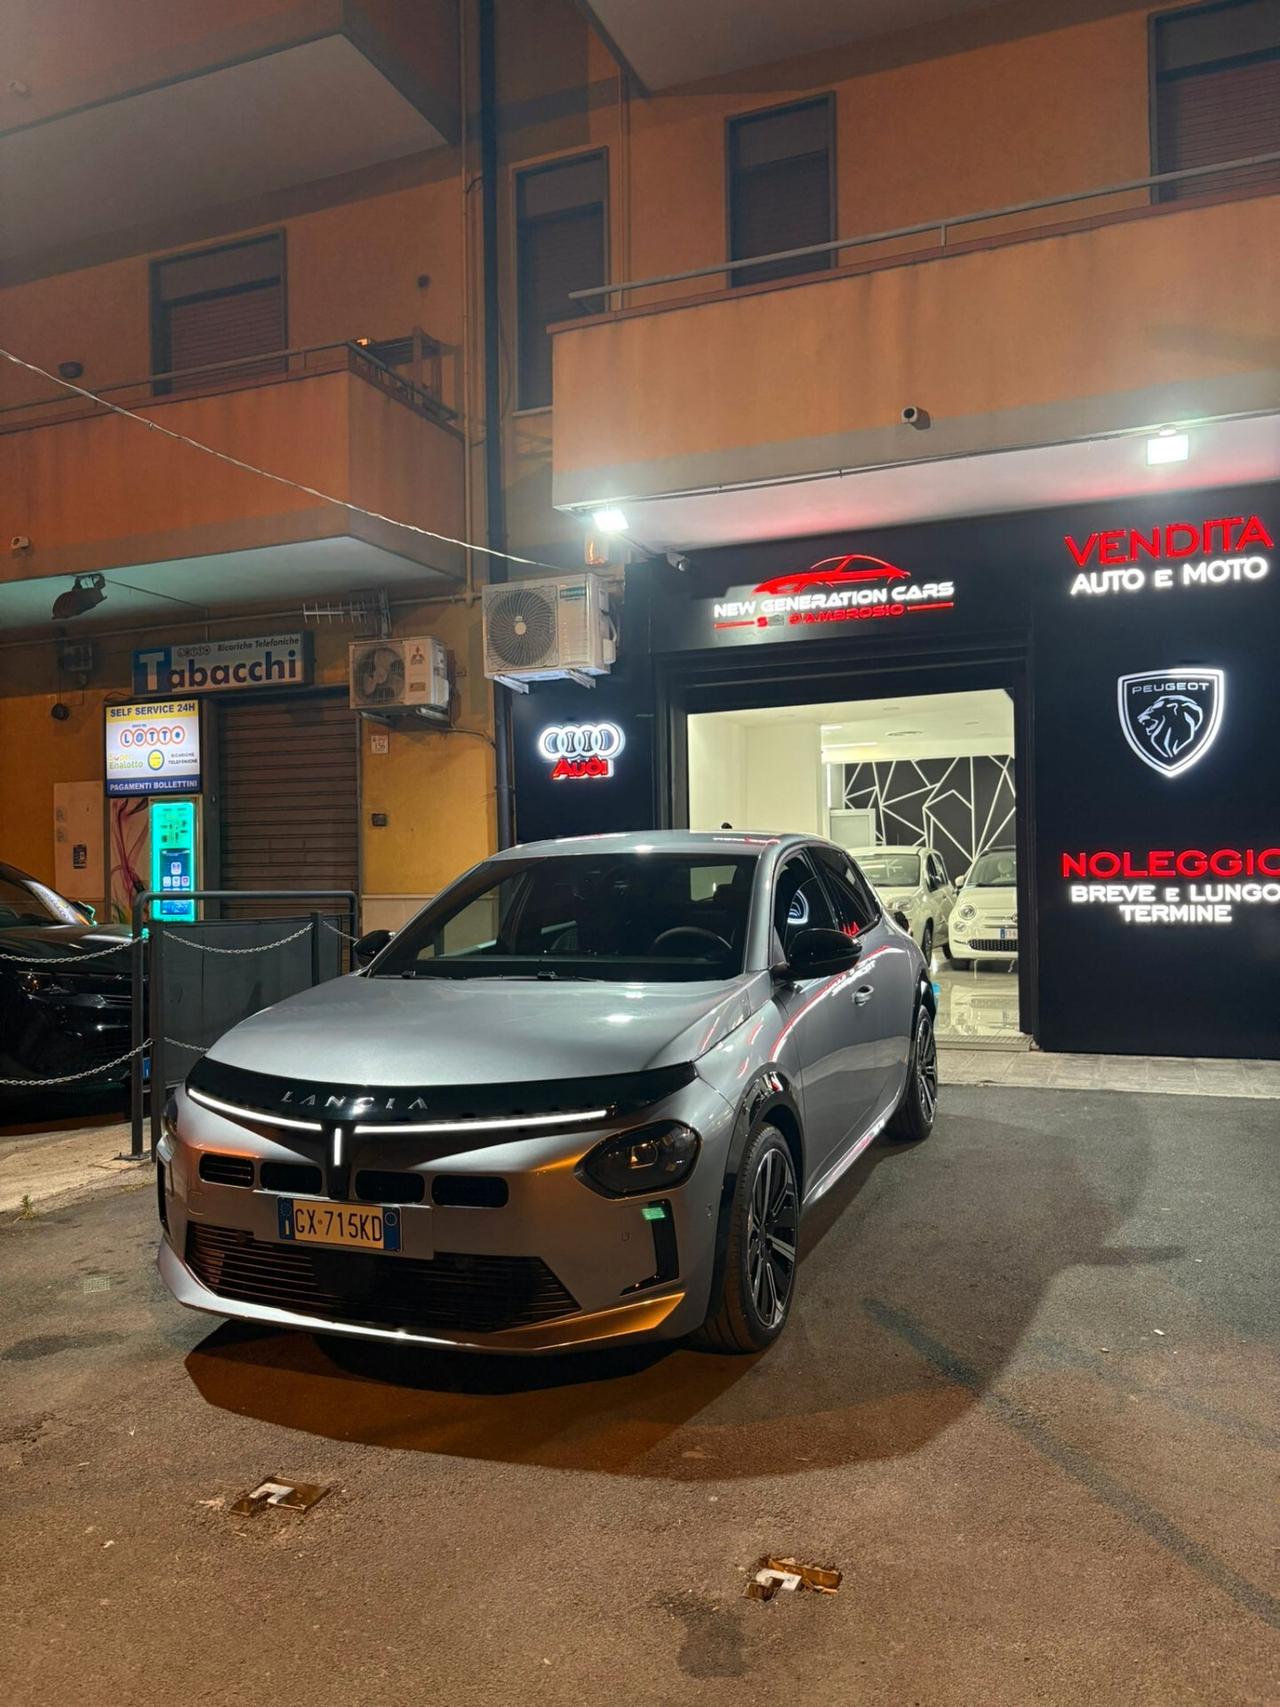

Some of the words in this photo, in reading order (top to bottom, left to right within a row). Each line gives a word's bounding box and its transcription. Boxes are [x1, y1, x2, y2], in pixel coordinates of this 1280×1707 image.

[1064, 515, 1275, 567] VENDITA
[1070, 569, 1144, 595] AUTO
[1155, 570, 1173, 588] E
[1183, 557, 1268, 585] MOTO
[714, 601, 756, 618] NEW
[760, 588, 889, 613] GENERATION
[891, 581, 954, 600] CARS
[255, 637, 299, 648] Telefoniche
[139, 650, 297, 690] Tabacchi
[1132, 681, 1209, 694] PEUGEOT
[110, 708, 132, 717] SELF
[135, 704, 174, 716] SERVICE
[177, 702, 195, 712] 24H
[109, 760, 144, 770] Enalotto
[110, 782, 152, 791] PAGAMENTI
[153, 780, 198, 789] BOLLETTINI
[1062, 848, 1280, 879] NOLEGGIO
[1071, 885, 1156, 902] BREVE
[1190, 883, 1280, 903] LUNGO
[1119, 904, 1233, 923] TERMINE
[281, 1091, 428, 1110] LANCIA
[324, 1210, 383, 1241] 715KD
